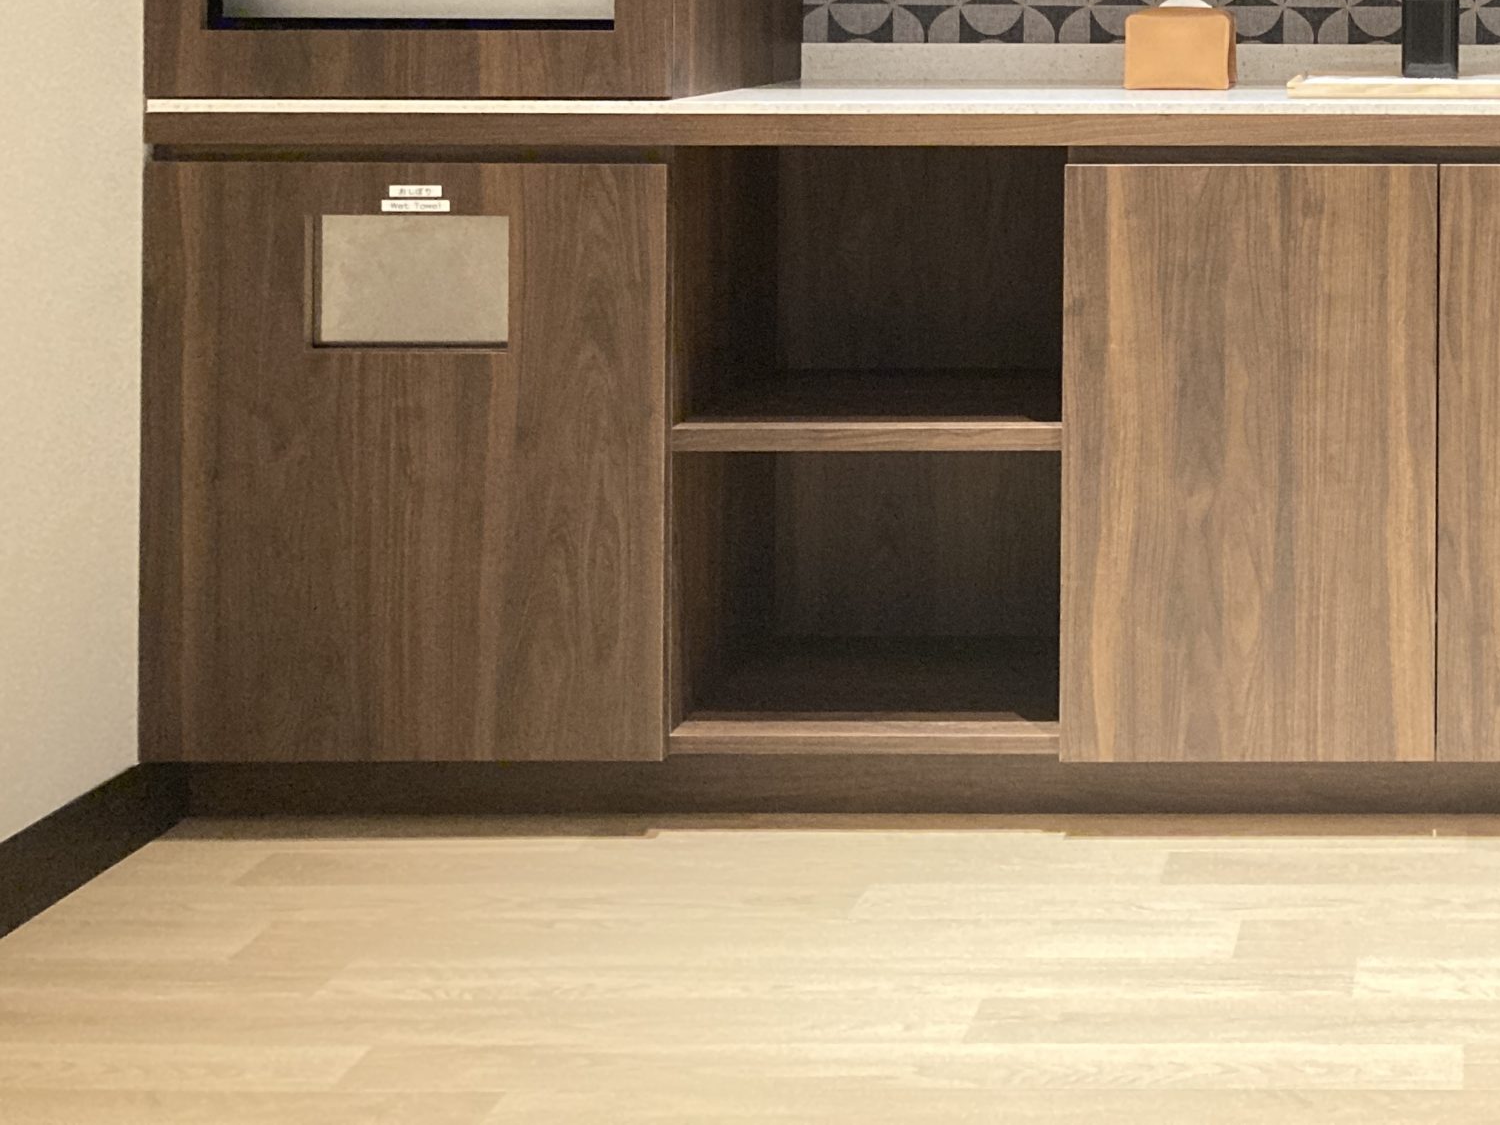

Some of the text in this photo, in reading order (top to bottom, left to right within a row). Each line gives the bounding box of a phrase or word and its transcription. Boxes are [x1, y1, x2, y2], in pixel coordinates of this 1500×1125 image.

[398, 187, 432, 196] おしぼり
[390, 201, 442, 210] Wet Towel
